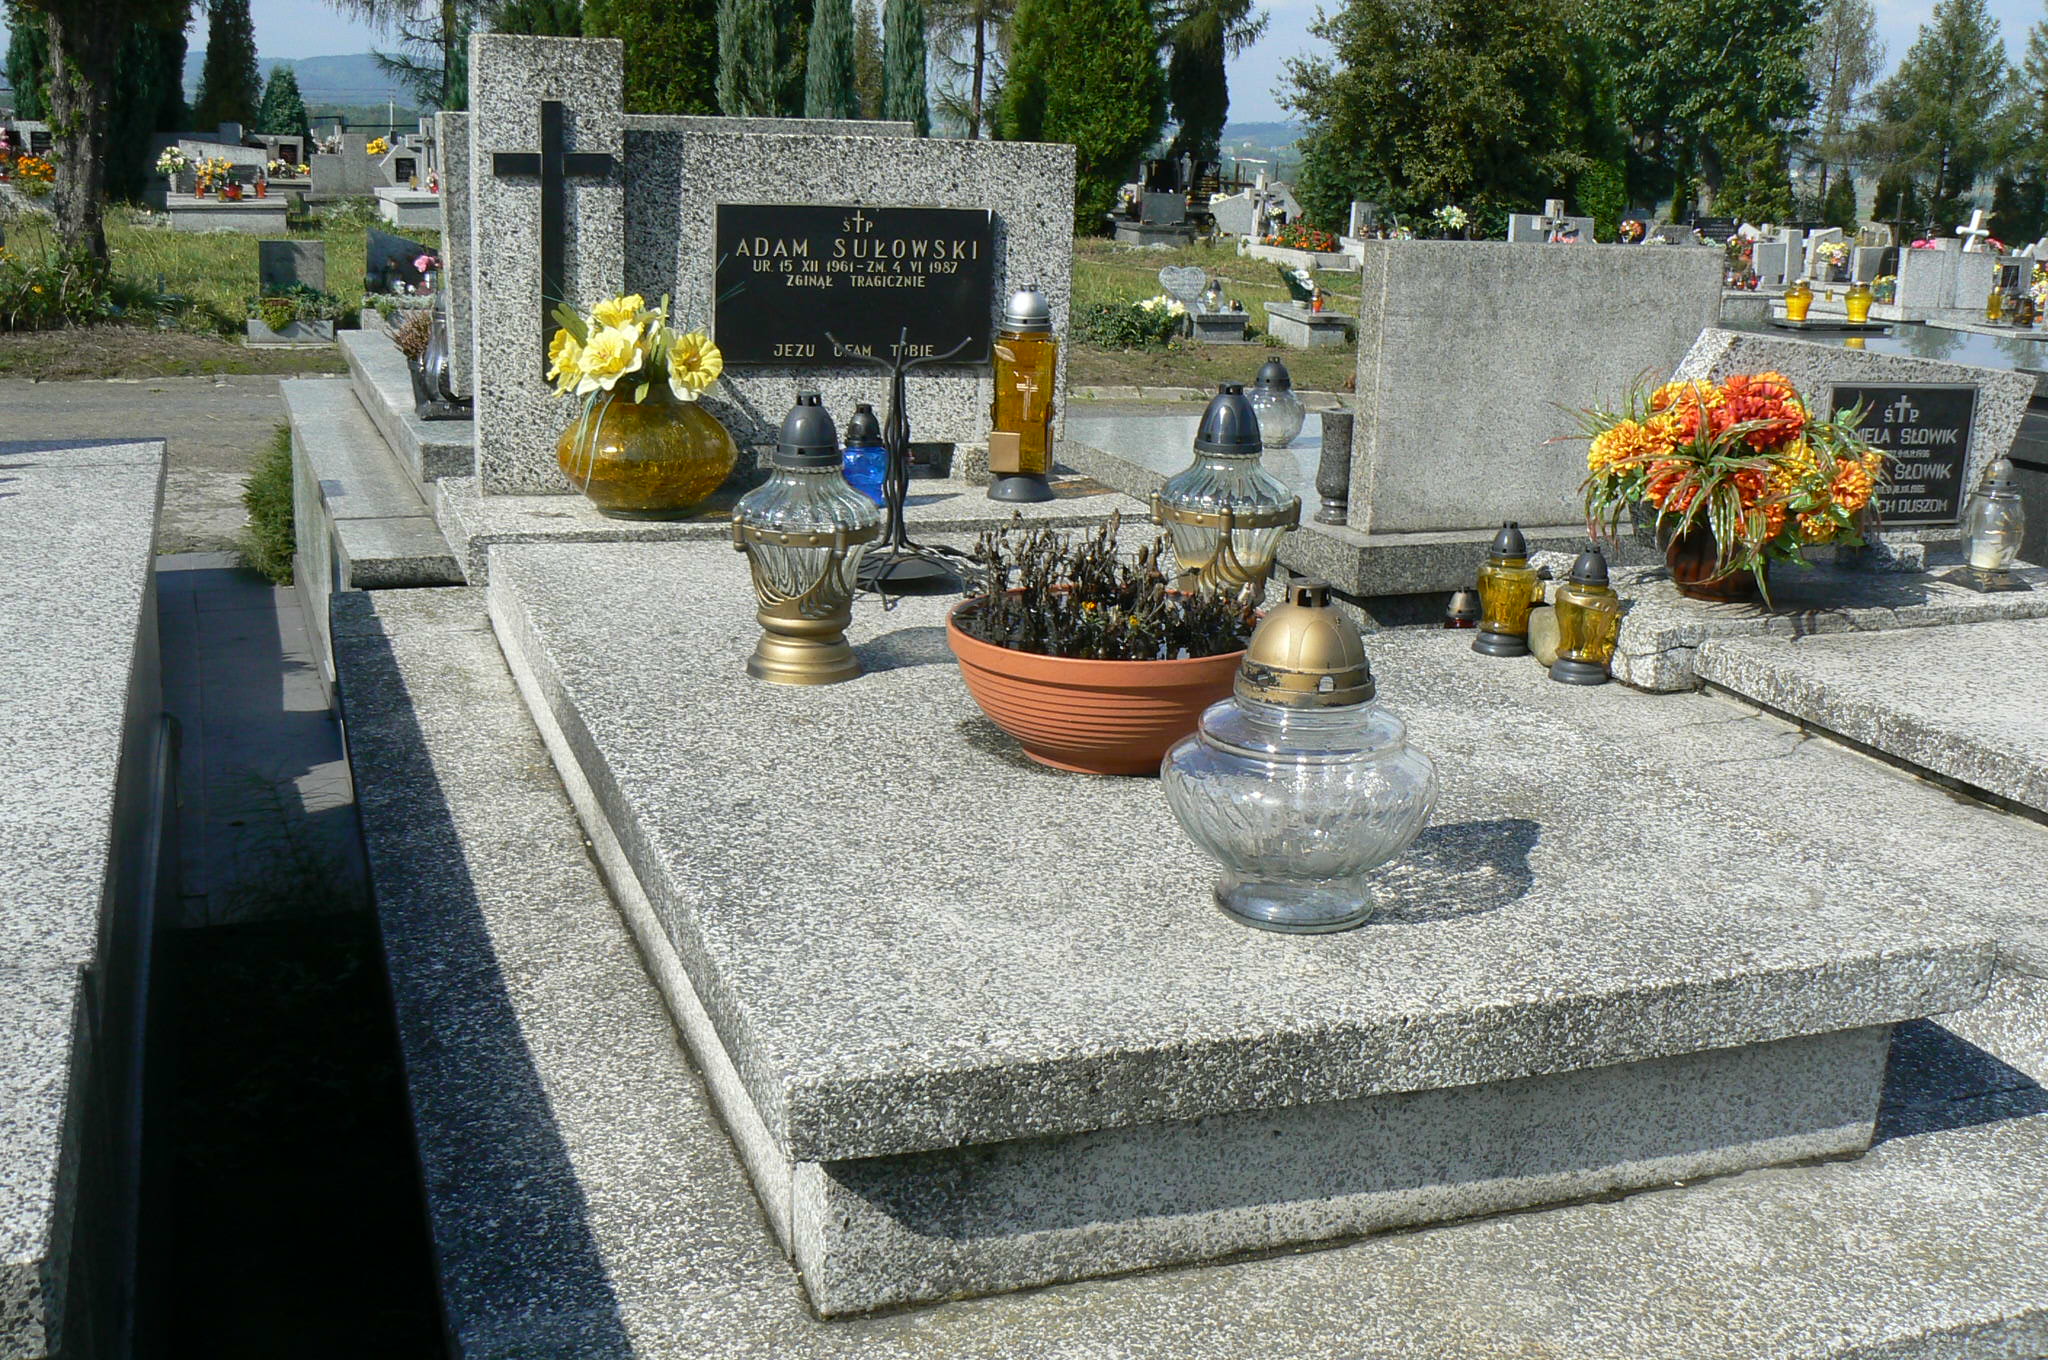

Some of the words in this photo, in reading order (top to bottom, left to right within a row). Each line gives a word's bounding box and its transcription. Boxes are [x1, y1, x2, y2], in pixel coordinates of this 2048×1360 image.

[735, 237, 808, 257] ADAM
[833, 238, 978, 260] SUŁOWSKI
[753, 260, 773, 273] UR.
[780, 260, 792, 272] 15
[802, 260, 818, 273] XII
[827, 260, 854, 273] 1961
[893, 261, 901, 273] 4
[910, 262, 922, 274] VI
[929, 261, 958, 274] 1987
[786, 275, 833, 289] ZGINĄŁ
[850, 275, 926, 288] TRAGICZNIE
[774, 344, 815, 357] JEZU
[890, 344, 934, 357] TBIE
[1900, 428, 1959, 445] SŁOWIK
[1894, 464, 1952, 480] SŁOWIK
[1898, 499, 1948, 513] DUSZOM
